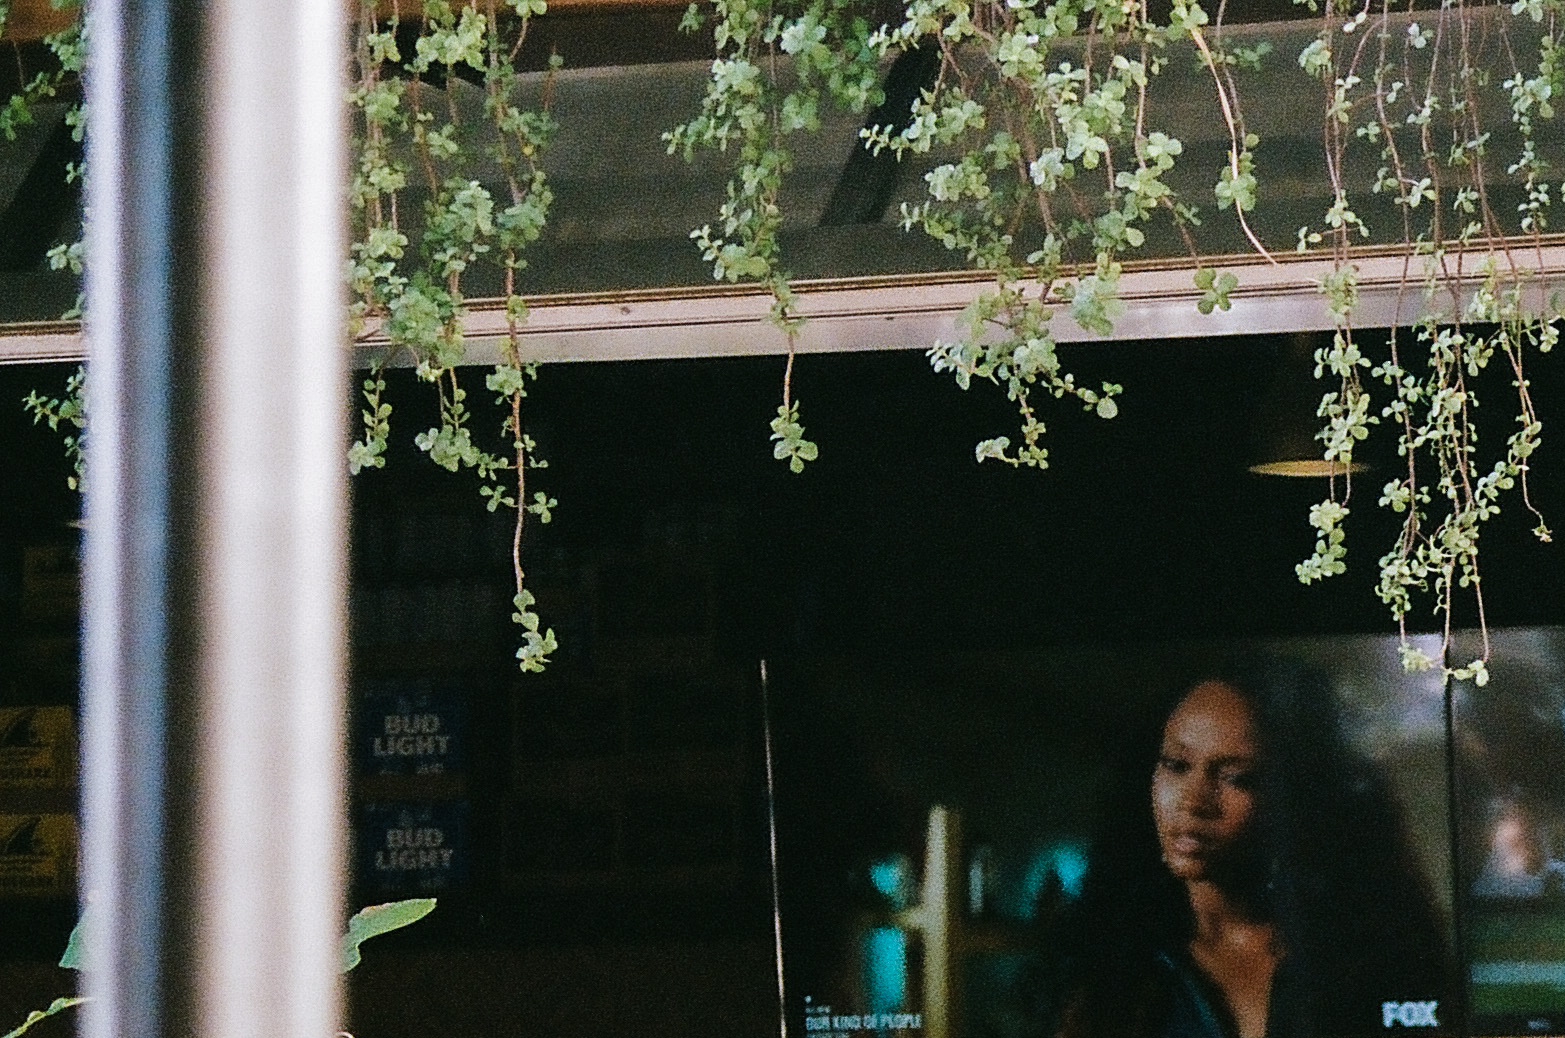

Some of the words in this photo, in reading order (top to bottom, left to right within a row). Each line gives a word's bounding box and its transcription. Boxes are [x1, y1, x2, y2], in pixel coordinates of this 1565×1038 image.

[384, 714, 440, 735] BUD
[373, 735, 450, 756] LIGHT
[387, 828, 444, 848] BUD
[375, 849, 453, 870] LIGHT
[1382, 1000, 1439, 1027] FOX
